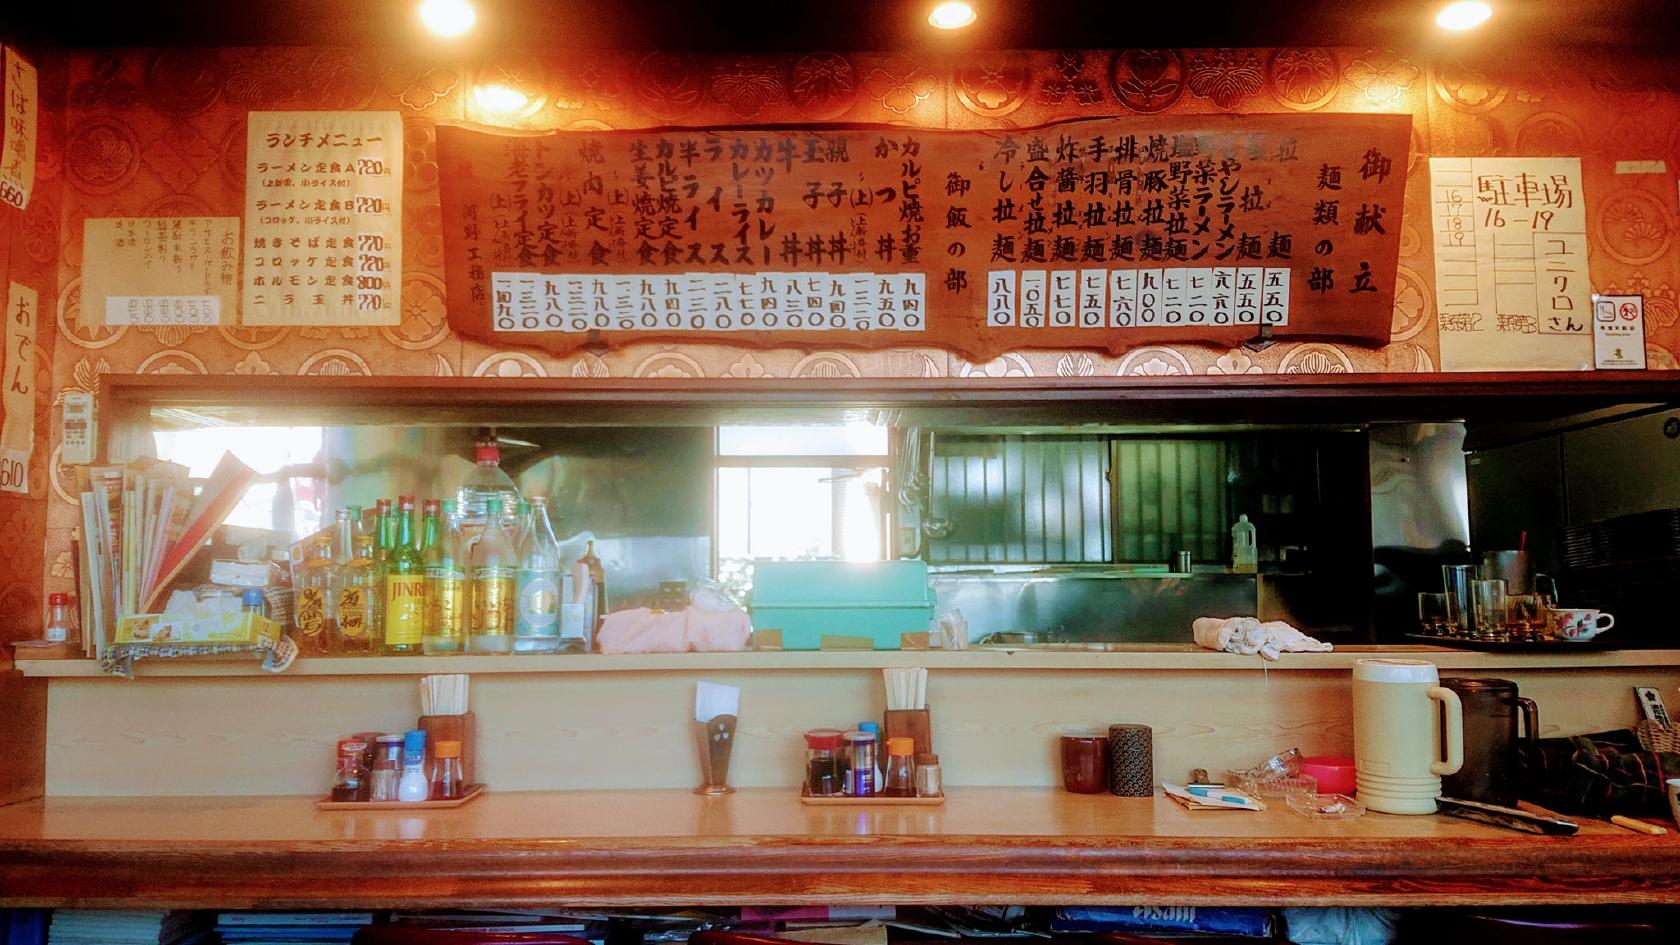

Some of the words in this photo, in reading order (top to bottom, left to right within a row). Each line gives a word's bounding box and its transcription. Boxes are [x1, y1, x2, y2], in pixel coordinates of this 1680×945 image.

[257, 162, 355, 174] ラーメン定食A
[266, 132, 382, 149] ランチメニュー
[535, 139, 564, 266] トンカツ定食
[580, 139, 611, 266] 焼肉定食
[629, 138, 660, 266] 生姜焼定食
[680, 138, 706, 266] 半ライス
[704, 138, 729, 266] ライス
[729, 138, 754, 266] カレーライス
[755, 138, 775, 266] カツカレー
[775, 138, 803, 267] 牛丼
[825, 137, 850, 266] 親子丼
[875, 137, 900, 263] かつ丼
[991, 136, 1020, 264] 冷し拉麺
[1021, 136, 1049, 264] 盛合せ拉麺
[1081, 135, 1109, 263] 手羽拉麺
[1110, 134, 1138, 263] 排骨拉麺
[1140, 135, 1168, 261] 焼豚拉麺
[1445, 189, 1462, 203] 16
[1477, 173, 1572, 208] 駐車場
[254, 237, 354, 249] 焼きそば定食
[255, 256, 354, 268] コロッケ定食
[256, 200, 354, 211] ラーメン定食B
[945, 172, 972, 294] 御飯の部
[1307, 163, 1343, 294] 麺類の部
[1349, 147, 1392, 293] 御献立
[1446, 217, 1462, 231] 18
[1449, 232, 1464, 247] 19
[253, 294, 354, 305] ニラ玉丼
[254, 275, 354, 287] ホルモン定食
[11, 297, 31, 394] おでん
[0, 459, 24, 487] 610
